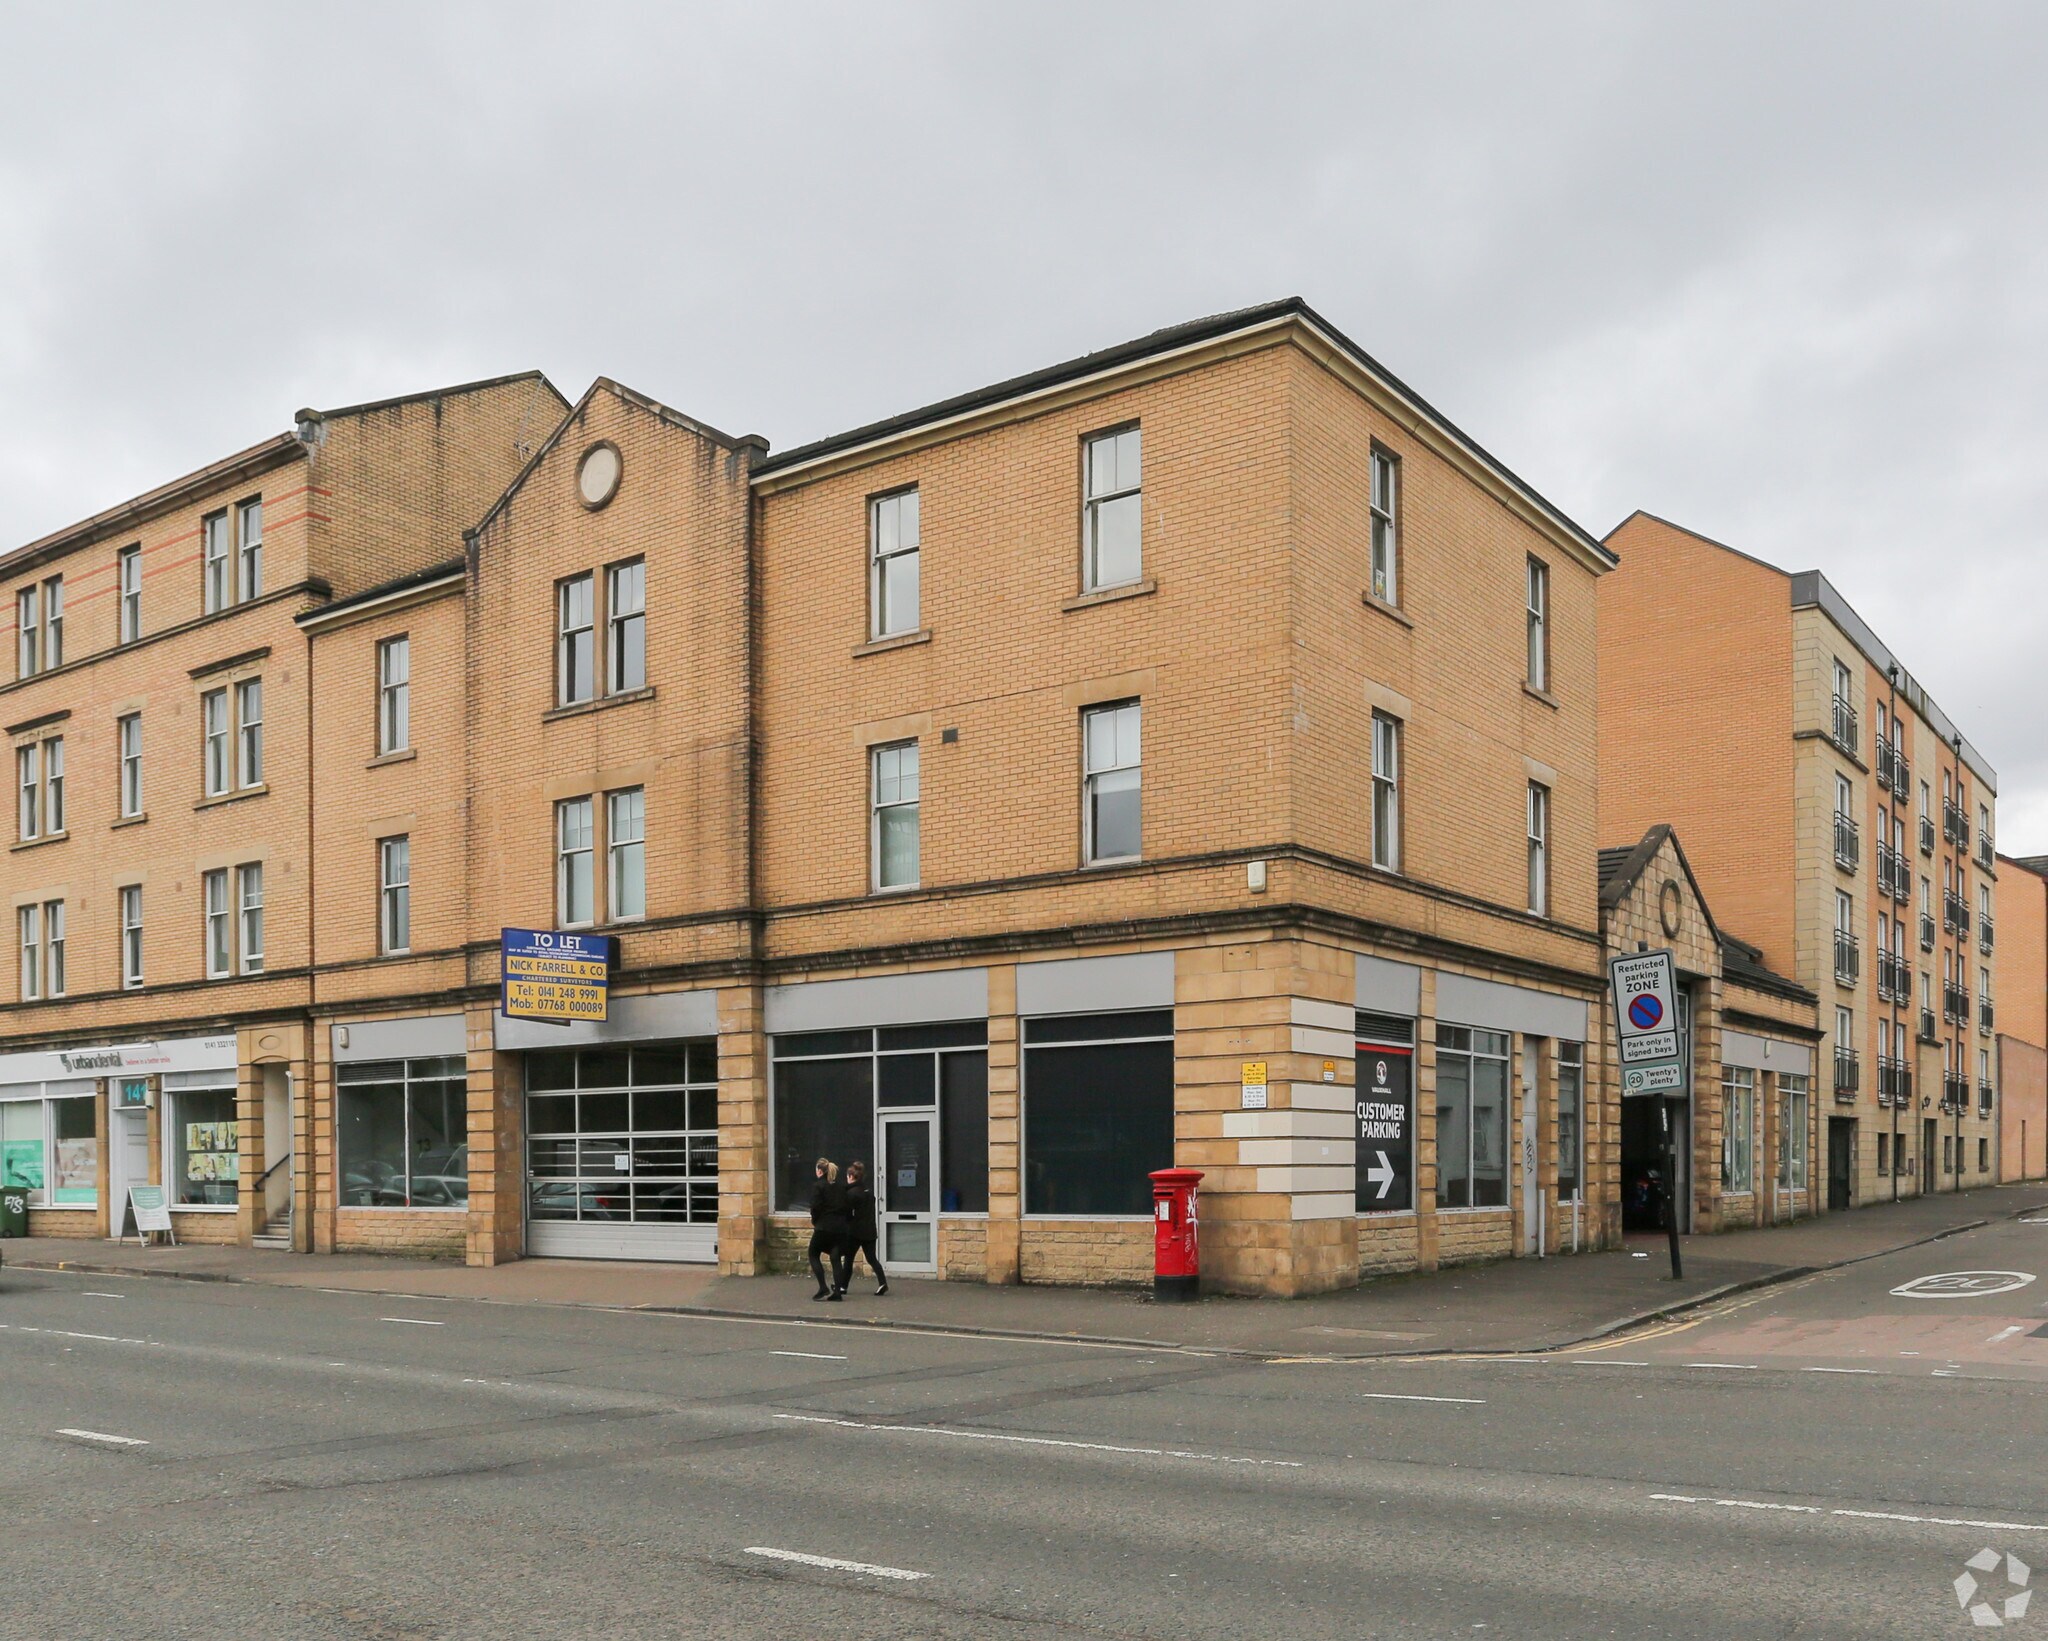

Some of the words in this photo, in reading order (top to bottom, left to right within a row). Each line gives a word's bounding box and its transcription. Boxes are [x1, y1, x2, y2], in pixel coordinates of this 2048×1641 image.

[533, 933, 553, 947] TO
[560, 935, 581, 949] LET
[510, 960, 532, 970] NICK
[537, 962, 575, 974] FARRELL
[579, 965, 585, 975] &
[590, 966, 605, 976] CO.
[1618, 959, 1664, 973] Restricted
[1625, 971, 1659, 983] parking
[516, 985, 533, 996] Tel:
[538, 987, 554, 996] 0141
[560, 988, 575, 998] 248
[580, 989, 598, 1000] 9991
[1626, 980, 1660, 992] ZONE
[510, 997, 533, 1008] Mob:
[538, 1000, 565, 1010] 07768
[570, 1001, 602, 1012] 000089
[1627, 1040, 1644, 1048] Park
[1646, 1038, 1662, 1047] only
[1628, 1049, 1651, 1057] signed
[1655, 1046, 1672, 1054] bays
[72, 1052, 123, 1070] urbandental
[1645, 1068, 1677, 1078] Twenty's
[1650, 1077, 1673, 1086] plenty
[1357, 1102, 1404, 1121] CUSTOMER
[1362, 1121, 1400, 1139] PARKING
[1915, 1278, 2017, 1289] 20
